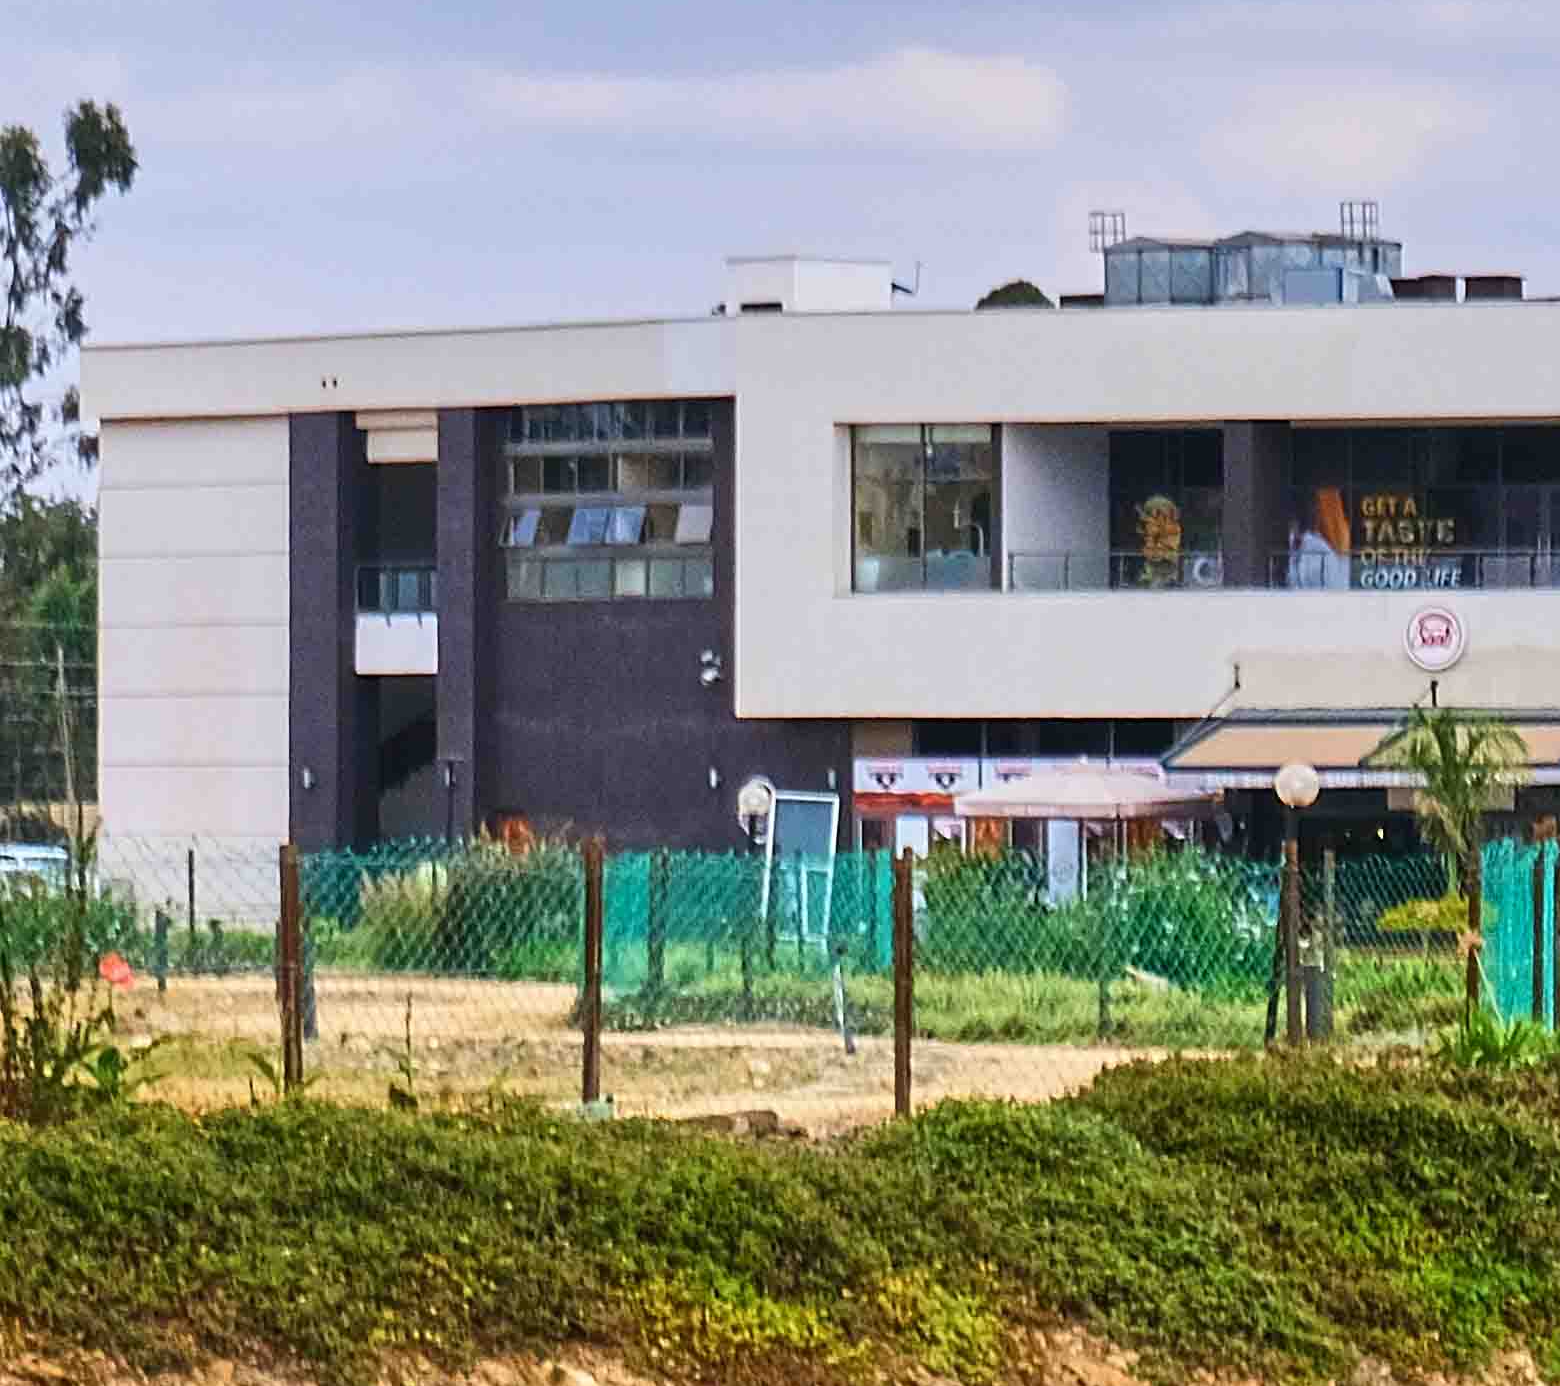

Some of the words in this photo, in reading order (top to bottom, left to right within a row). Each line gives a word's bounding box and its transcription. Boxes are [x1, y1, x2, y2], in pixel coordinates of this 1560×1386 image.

[1362, 495, 1396, 516] GET
[1403, 497, 1417, 516] A
[1362, 518, 1455, 544] TASTE
[1361, 568, 1416, 589] GOOD
